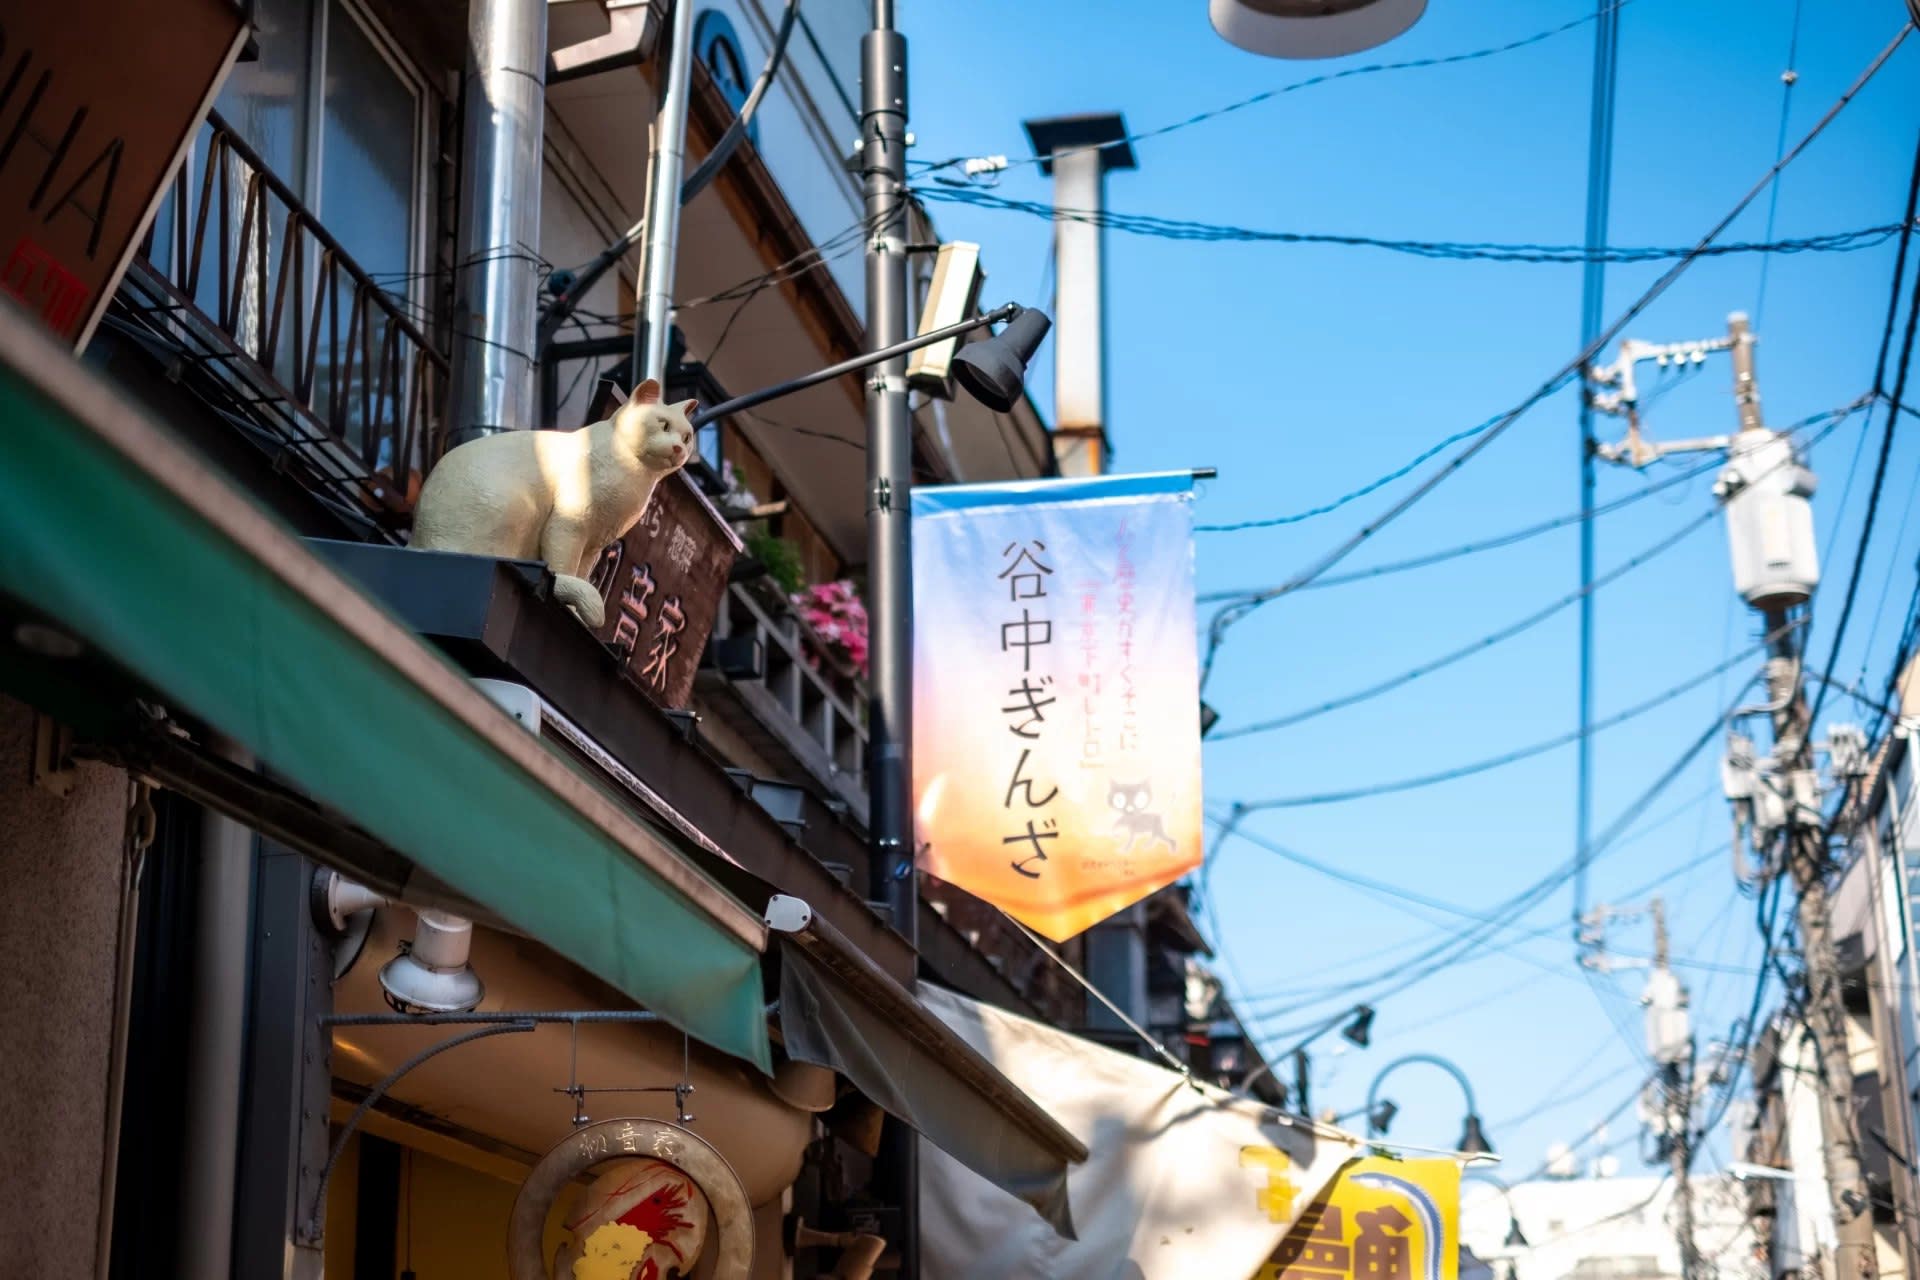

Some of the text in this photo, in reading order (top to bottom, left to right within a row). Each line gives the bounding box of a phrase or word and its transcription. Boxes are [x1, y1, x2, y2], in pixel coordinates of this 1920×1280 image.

[997, 539, 1060, 880] 谷中ぎんざ
